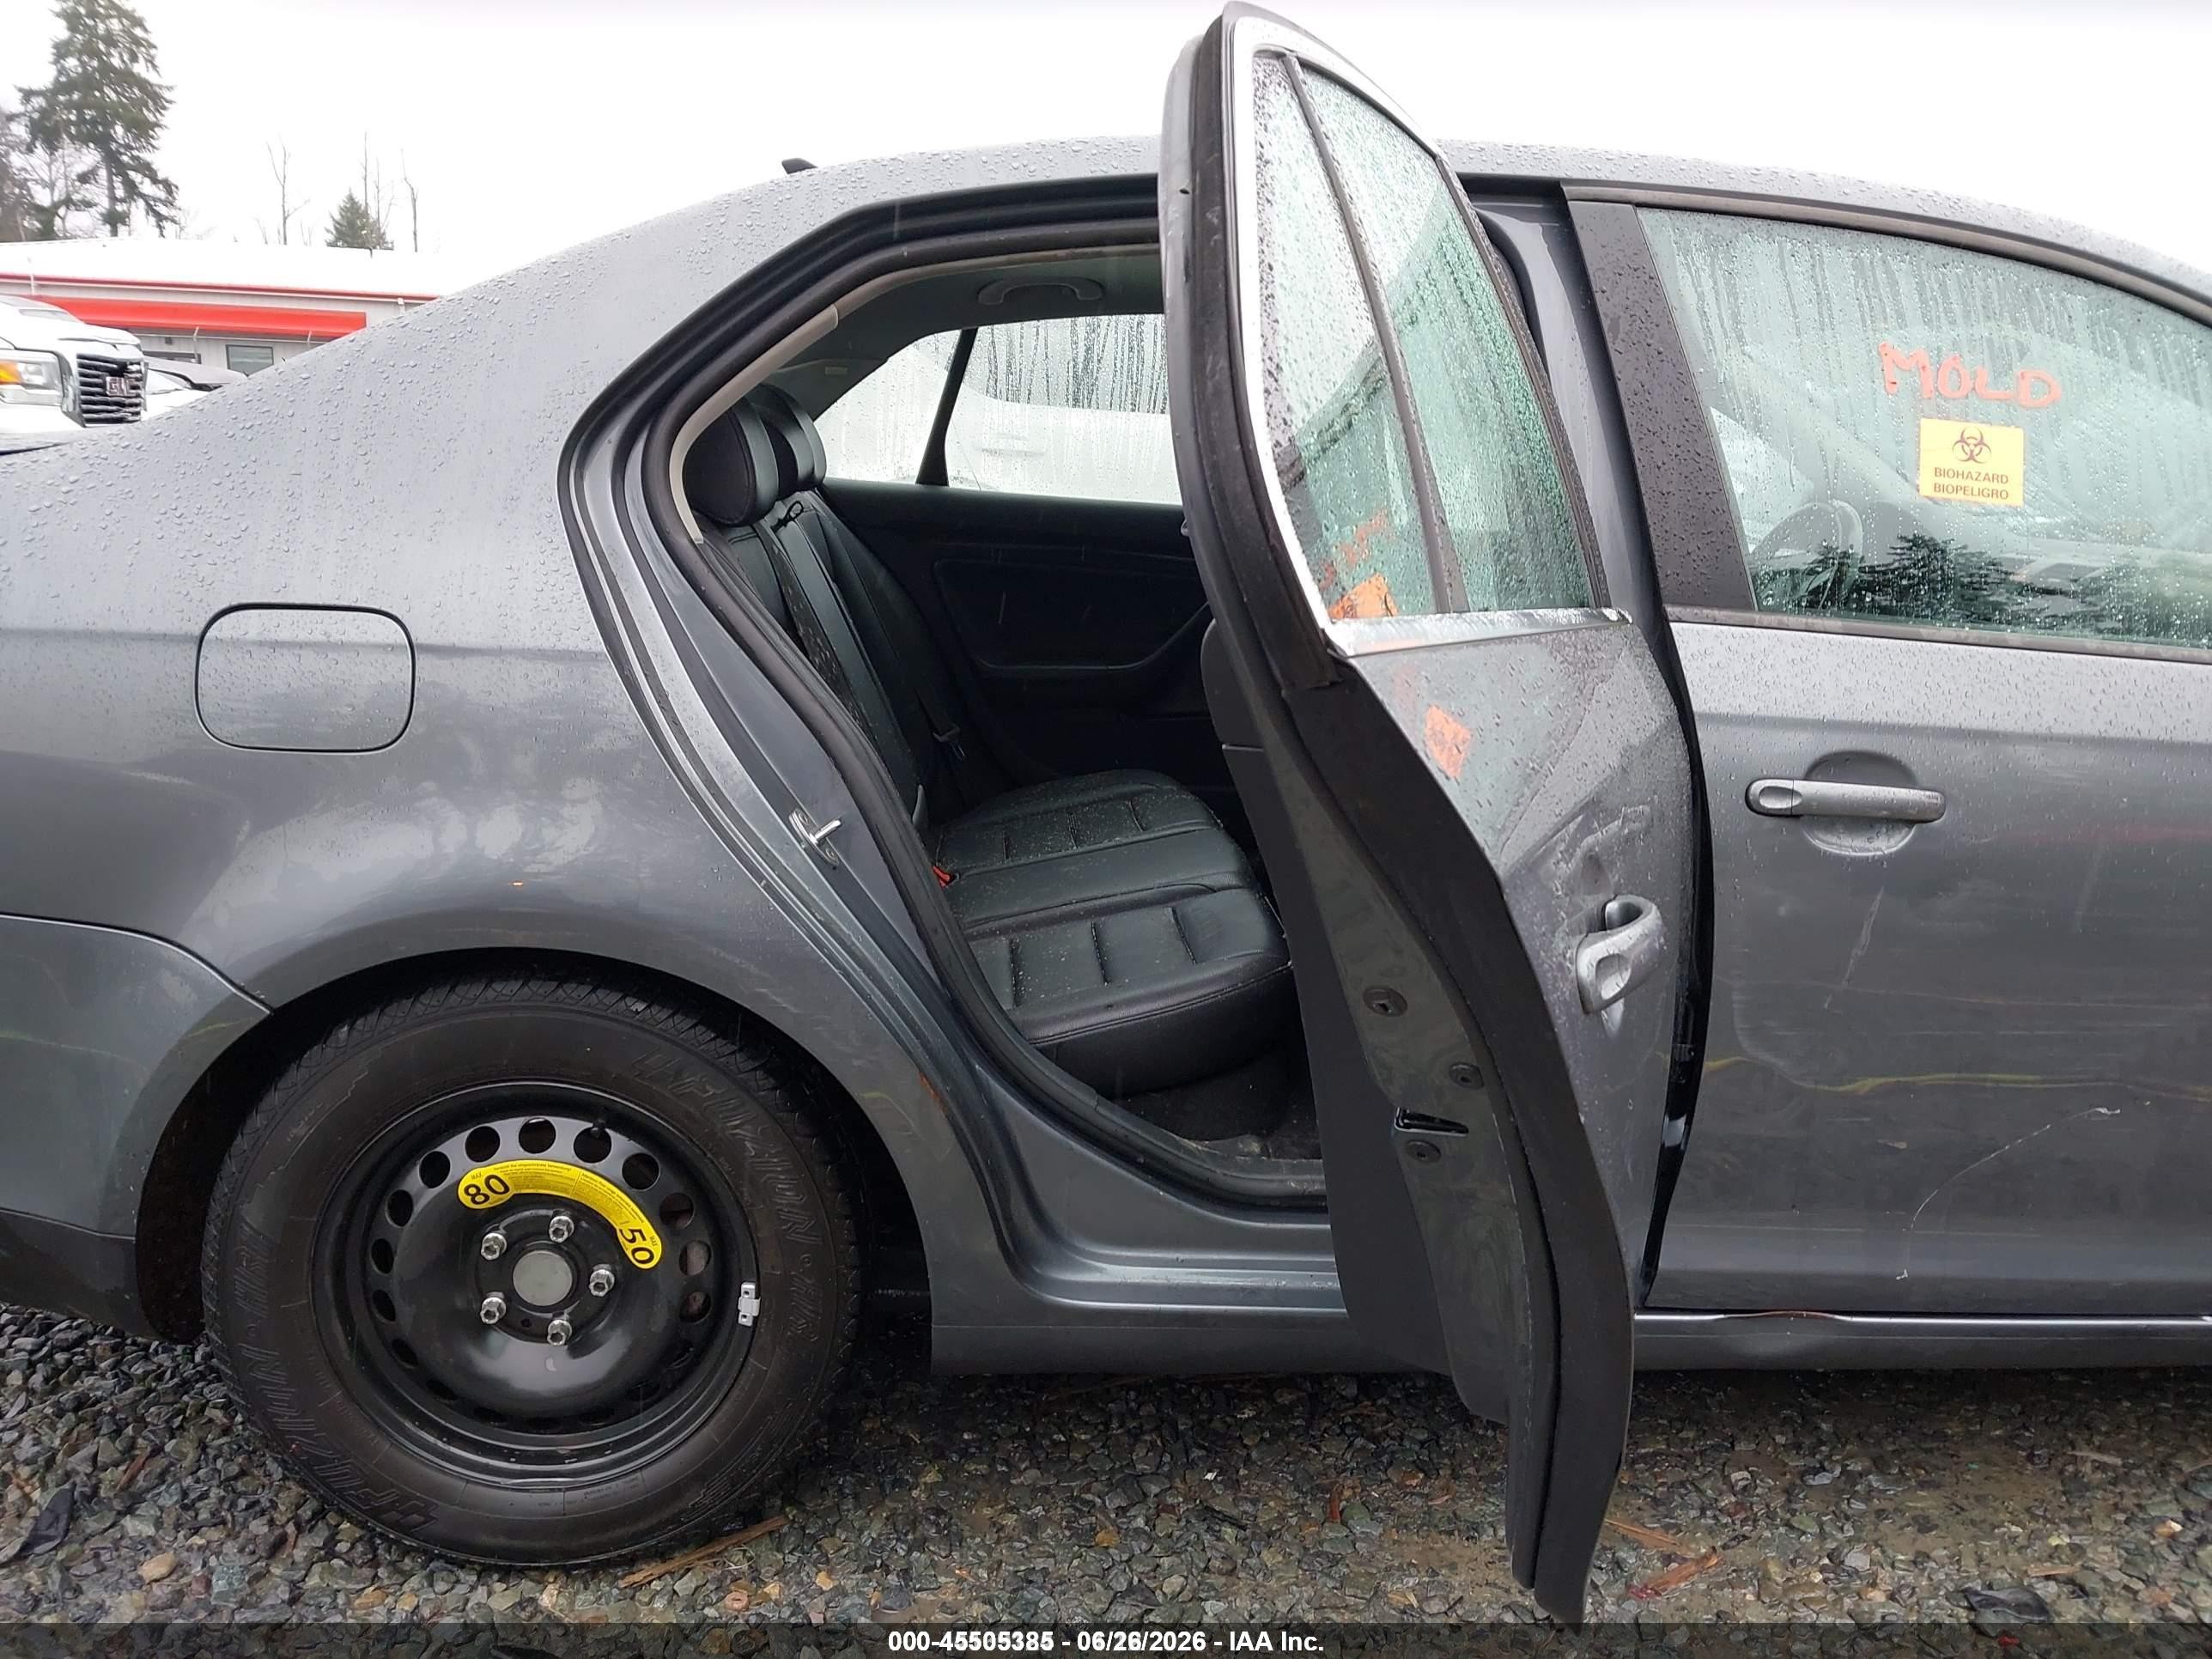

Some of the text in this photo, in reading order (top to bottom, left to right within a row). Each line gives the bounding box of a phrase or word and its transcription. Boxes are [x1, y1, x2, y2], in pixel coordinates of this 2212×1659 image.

[1879, 341, 2063, 409] MOLD
[1934, 466, 2009, 484] BIOHAZARD
[1933, 482, 2009, 500] BIOPELIGRO
[464, 1174, 510, 1205] 80
[618, 1228, 655, 1265] 50
